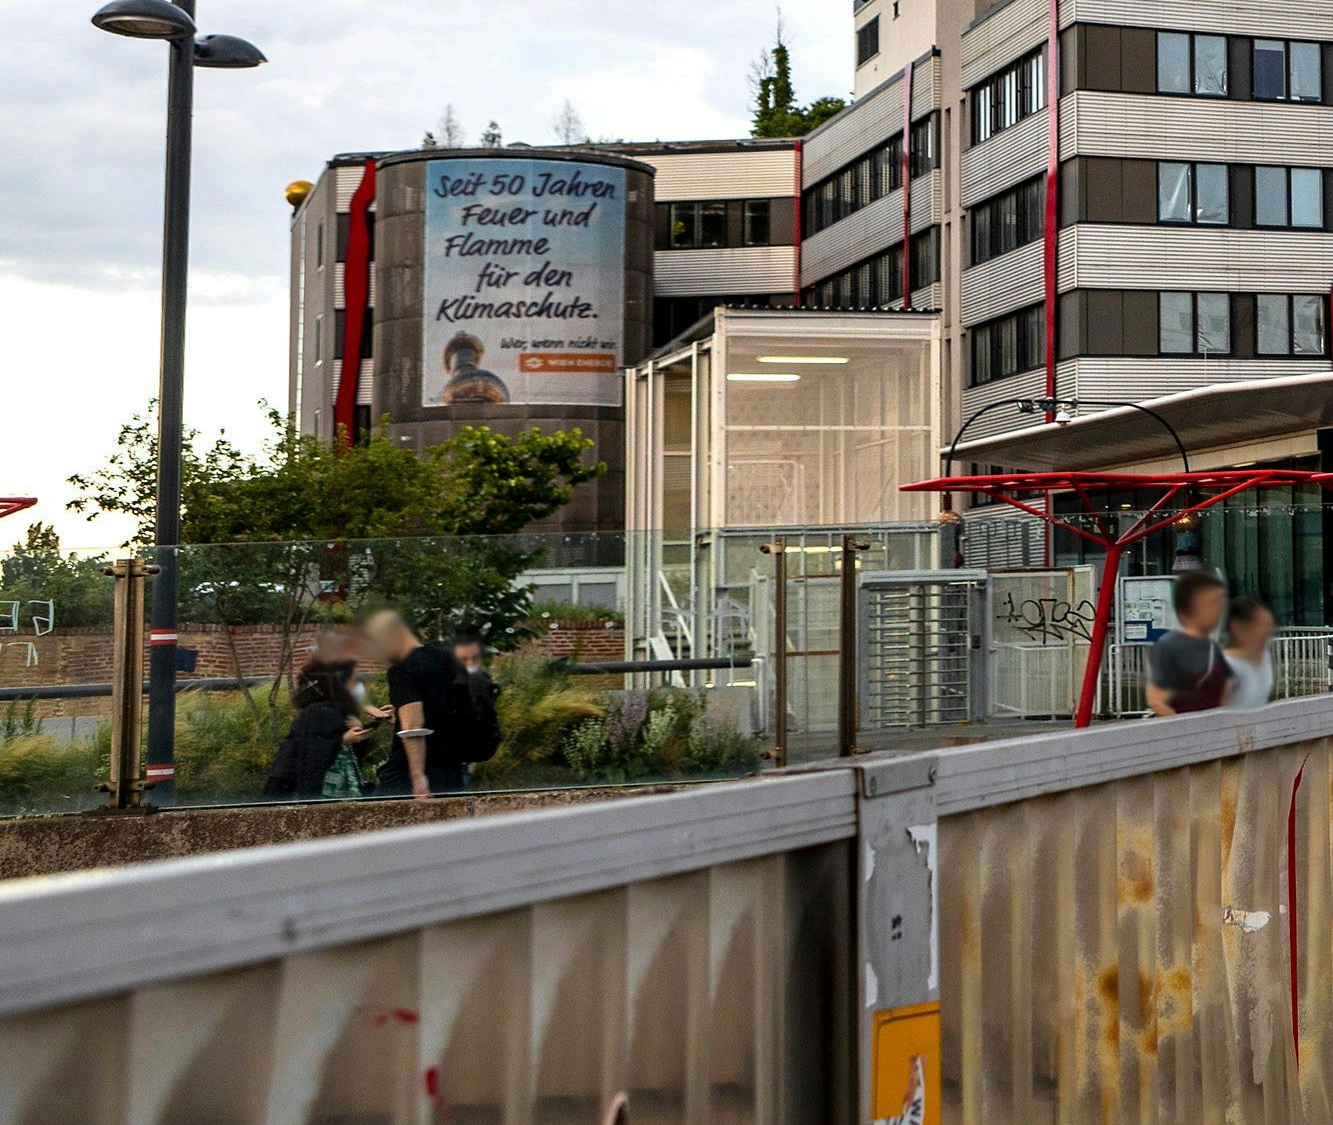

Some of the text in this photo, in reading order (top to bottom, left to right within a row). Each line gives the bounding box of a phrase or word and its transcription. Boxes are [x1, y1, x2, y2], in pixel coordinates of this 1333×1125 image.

[434, 171, 616, 200] Seit 50 Jahren
[461, 202, 598, 227] Feuer und
[444, 232, 551, 258] Flamme
[475, 261, 573, 293] für den
[436, 292, 599, 323] Klimaschutz.
